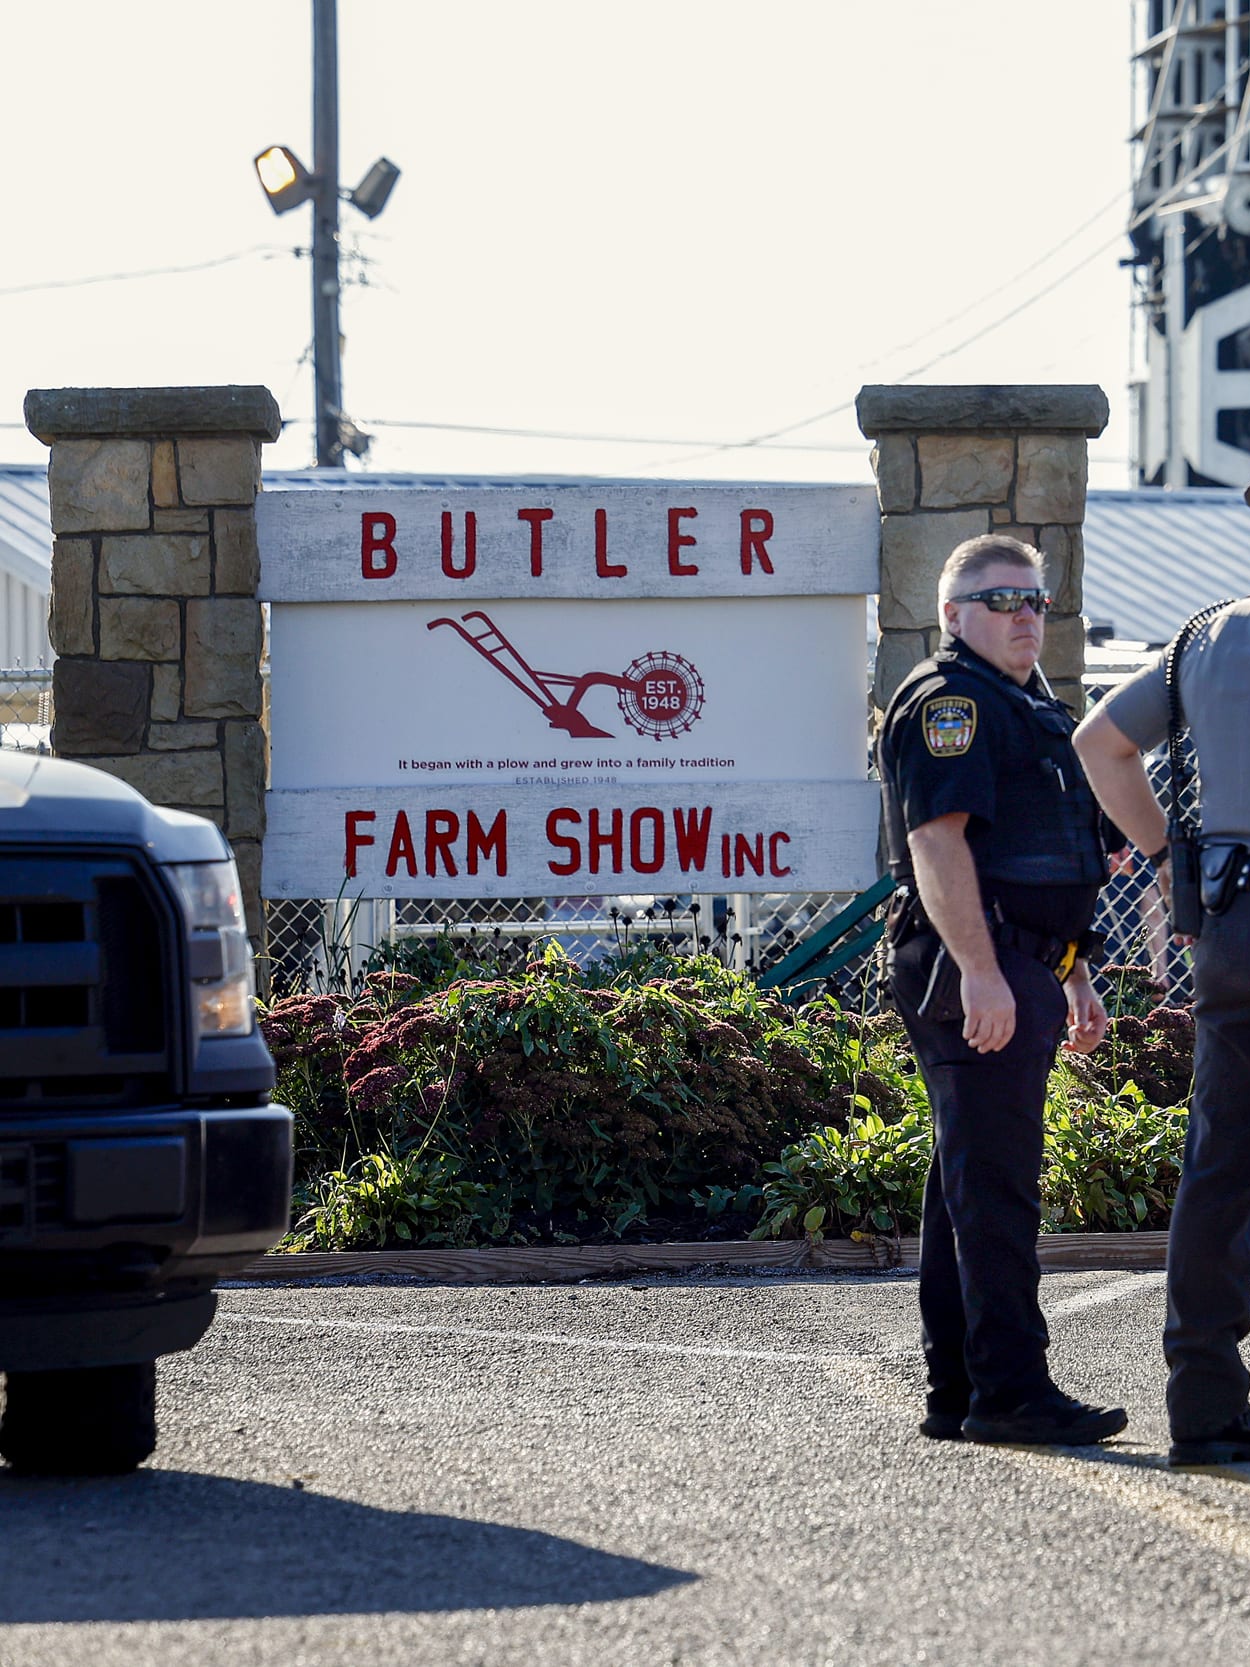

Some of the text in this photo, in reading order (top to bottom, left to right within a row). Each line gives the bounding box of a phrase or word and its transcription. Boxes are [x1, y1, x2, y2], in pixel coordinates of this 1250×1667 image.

[362, 508, 774, 579] BUTLER
[646, 681, 682, 694] EST.
[641, 695, 680, 710] 1948
[398, 756, 735, 772] It began with a plow and grew into a family tradition
[515, 775, 617, 785] ESTABLISHED 1948
[345, 807, 790, 878] FARM SHOW INC
